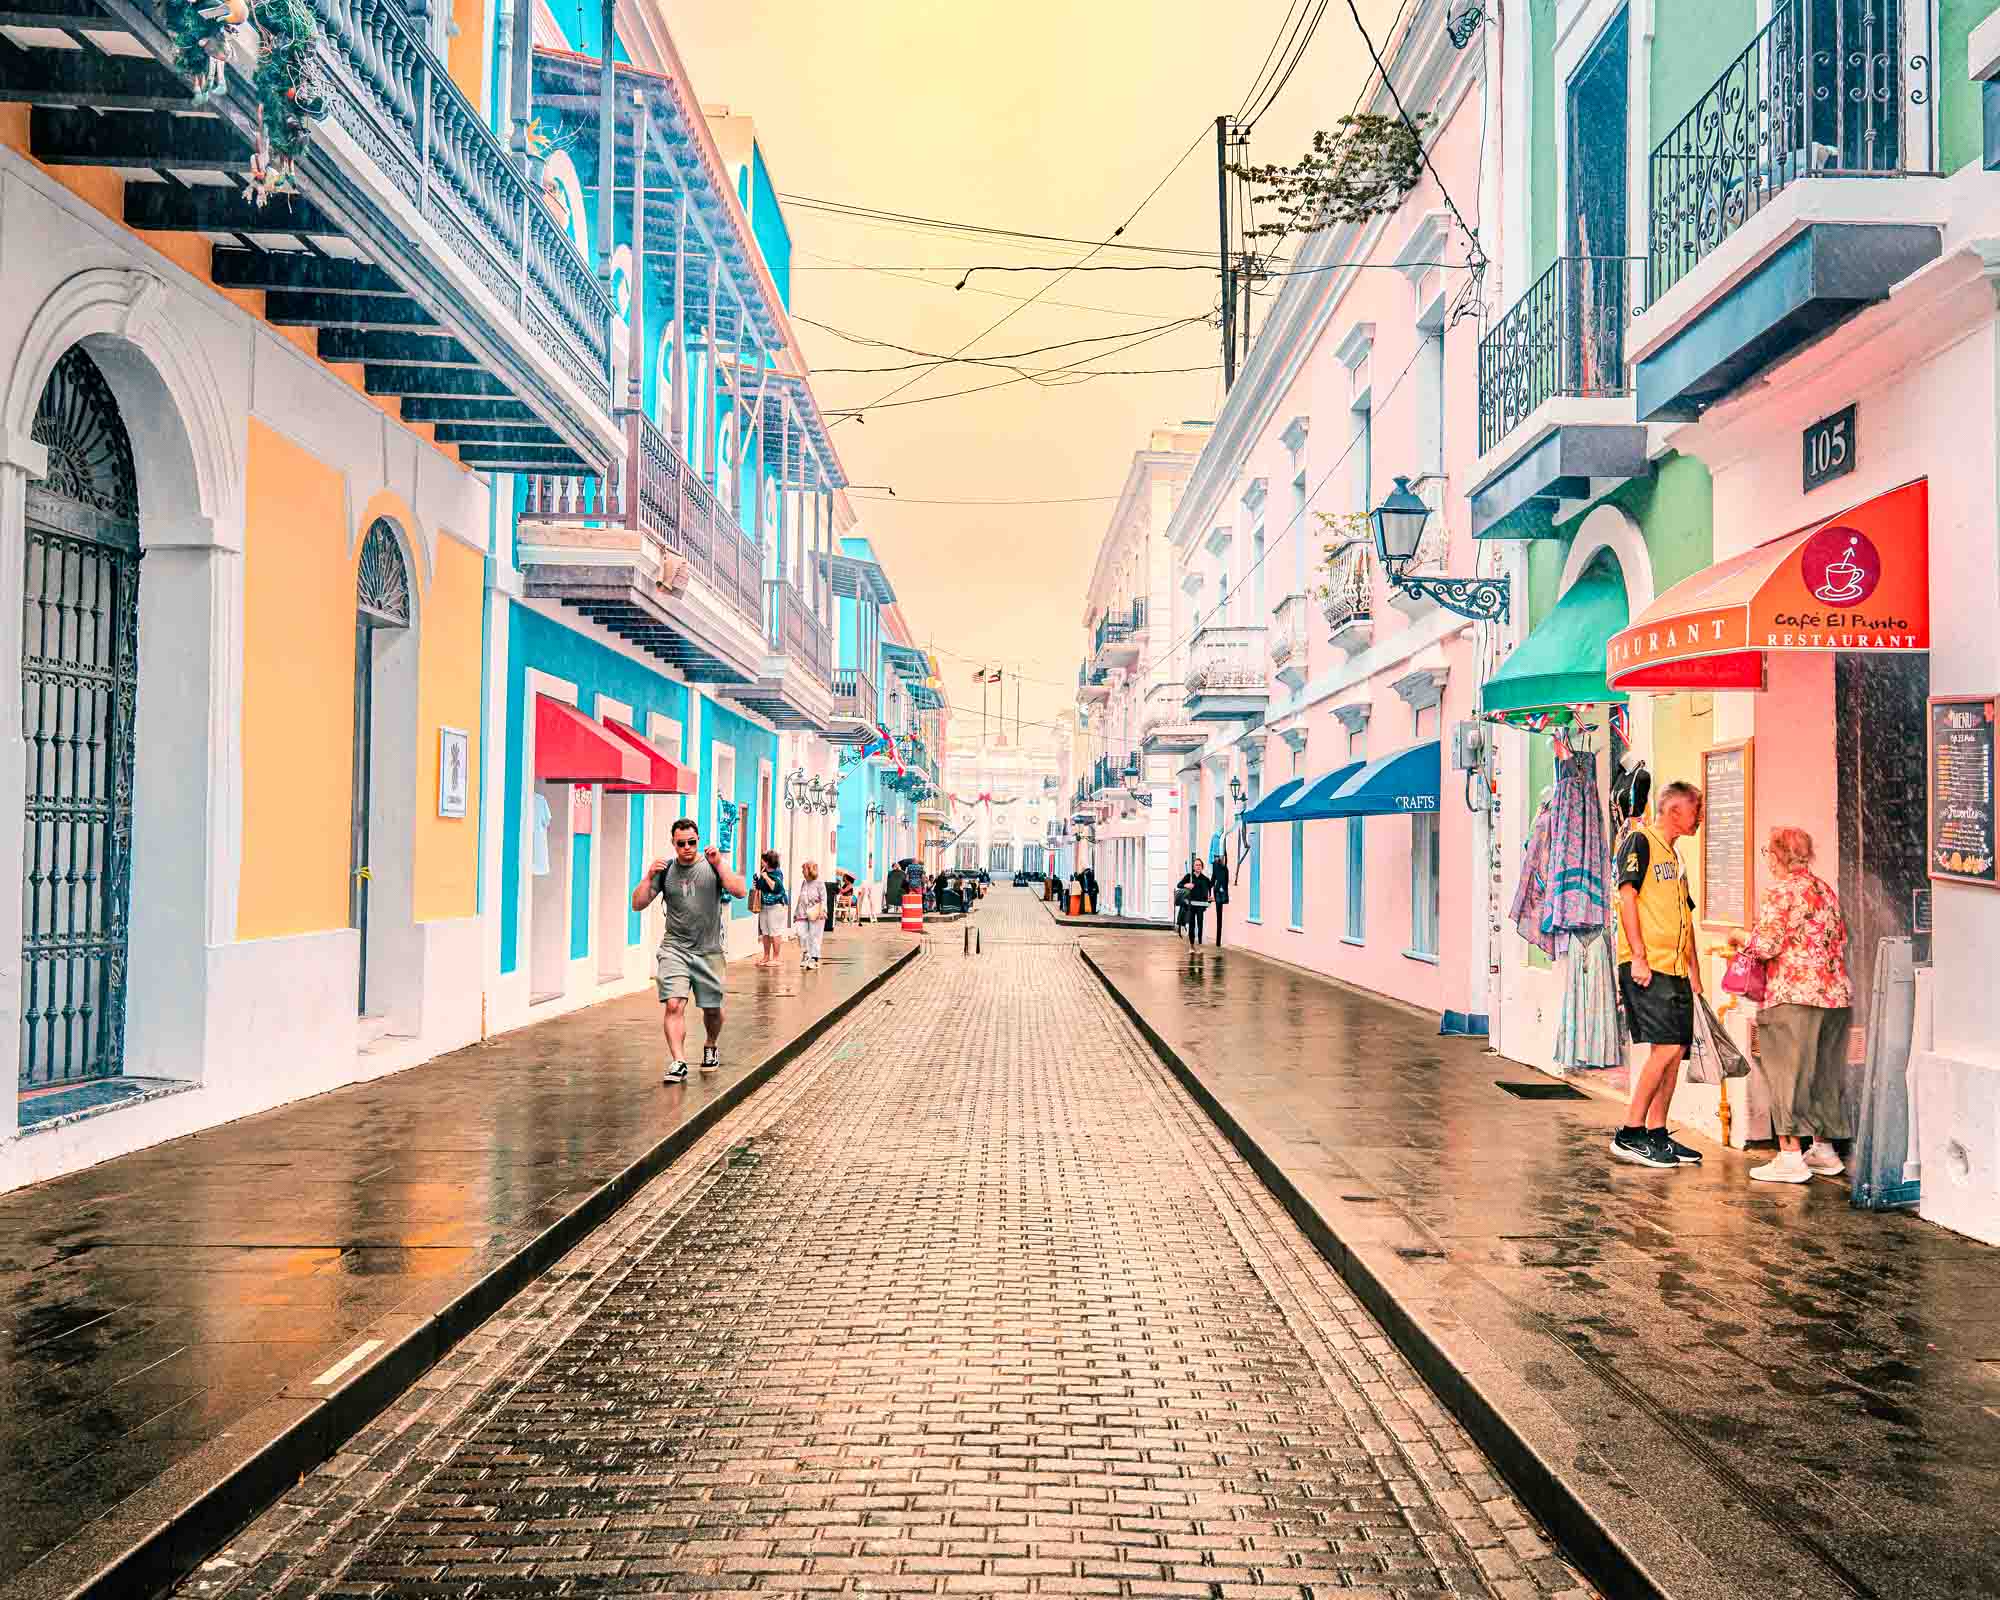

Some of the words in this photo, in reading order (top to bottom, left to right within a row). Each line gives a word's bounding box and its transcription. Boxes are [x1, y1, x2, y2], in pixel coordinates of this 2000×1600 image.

[1809, 420, 1846, 476] 105
[1775, 612, 1821, 630] Café
[1827, 613, 1844, 627] El
[1853, 614, 1908, 630] Punto
[1767, 634, 1916, 647] RESTAURANT
[1952, 711, 1972, 729] MENU
[1395, 795, 1435, 809] CRAFTS
